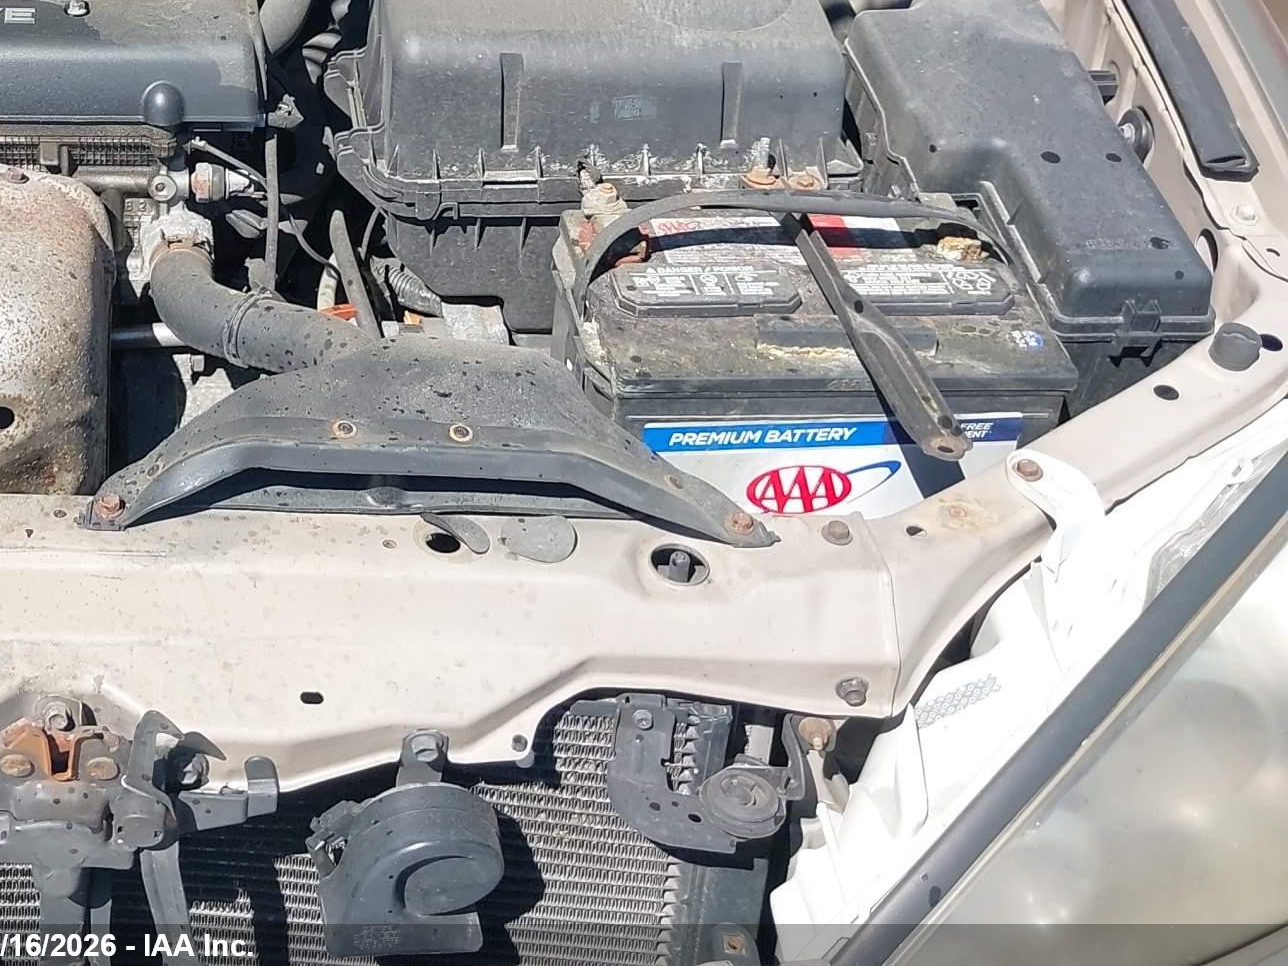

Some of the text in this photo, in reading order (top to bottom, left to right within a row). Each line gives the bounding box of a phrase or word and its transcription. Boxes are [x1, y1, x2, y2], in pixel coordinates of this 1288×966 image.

[959, 422, 993, 430] FREE
[668, 427, 857, 446] PREMIUM BATTERY
[753, 465, 848, 514] AAA
